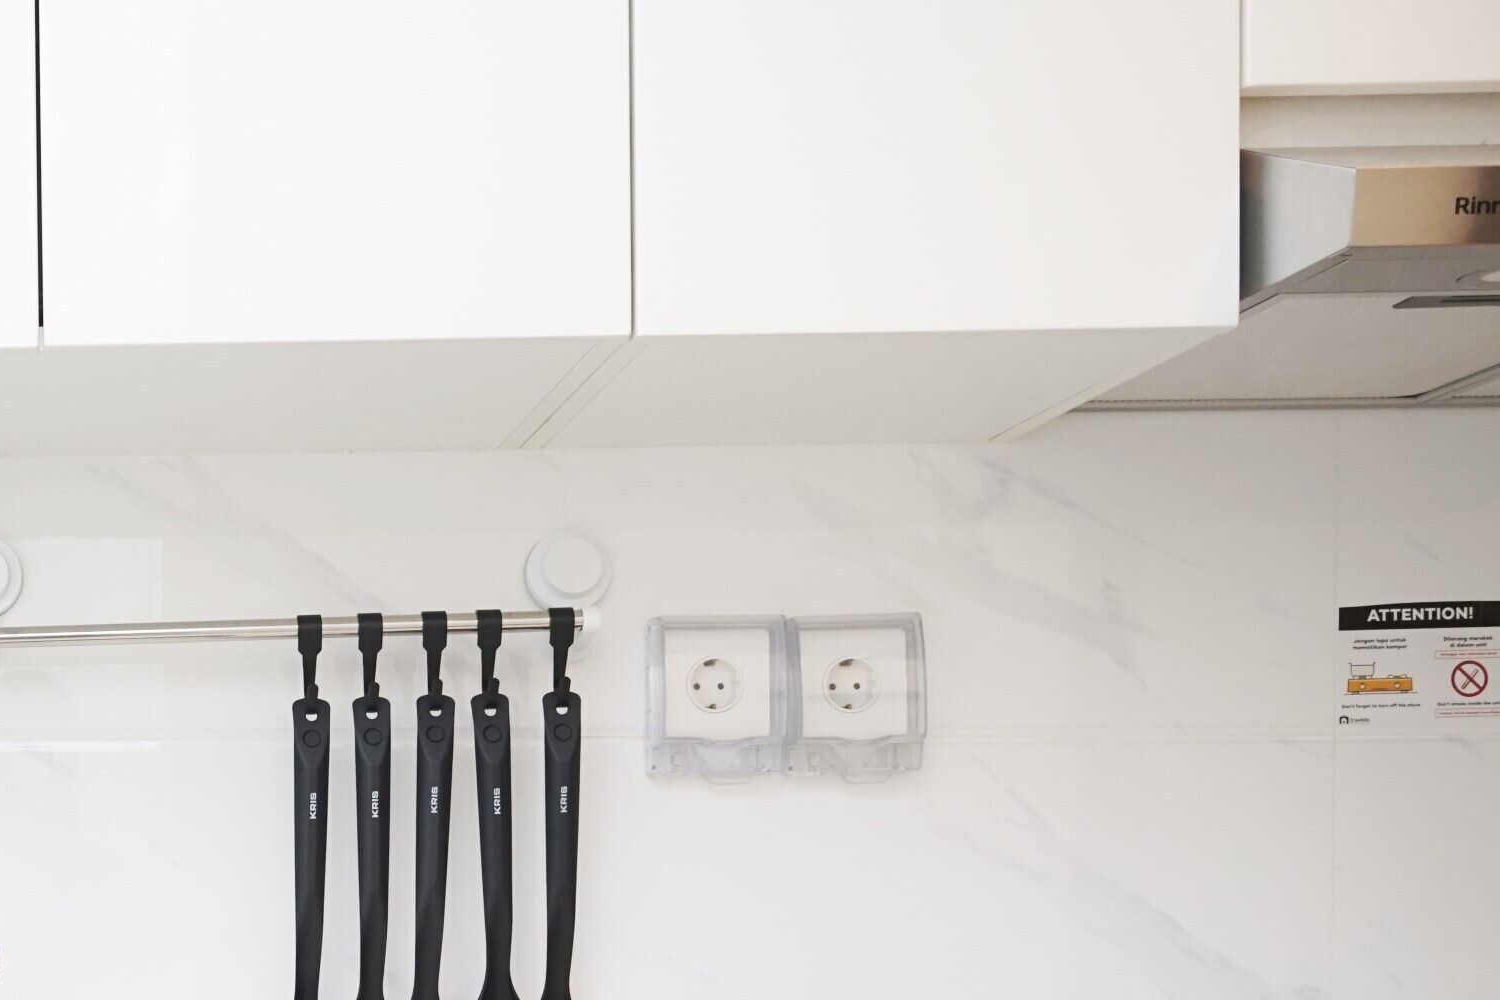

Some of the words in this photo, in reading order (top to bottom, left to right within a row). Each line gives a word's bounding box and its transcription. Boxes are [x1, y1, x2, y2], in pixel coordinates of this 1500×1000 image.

[1367, 607, 1474, 622] ATTENTION!
[309, 792, 317, 820] KRIS
[371, 790, 379, 818] KRIS
[431, 786, 439, 814] KRIS
[493, 787, 501, 815] KRIS
[560, 785, 568, 813] KRIS
